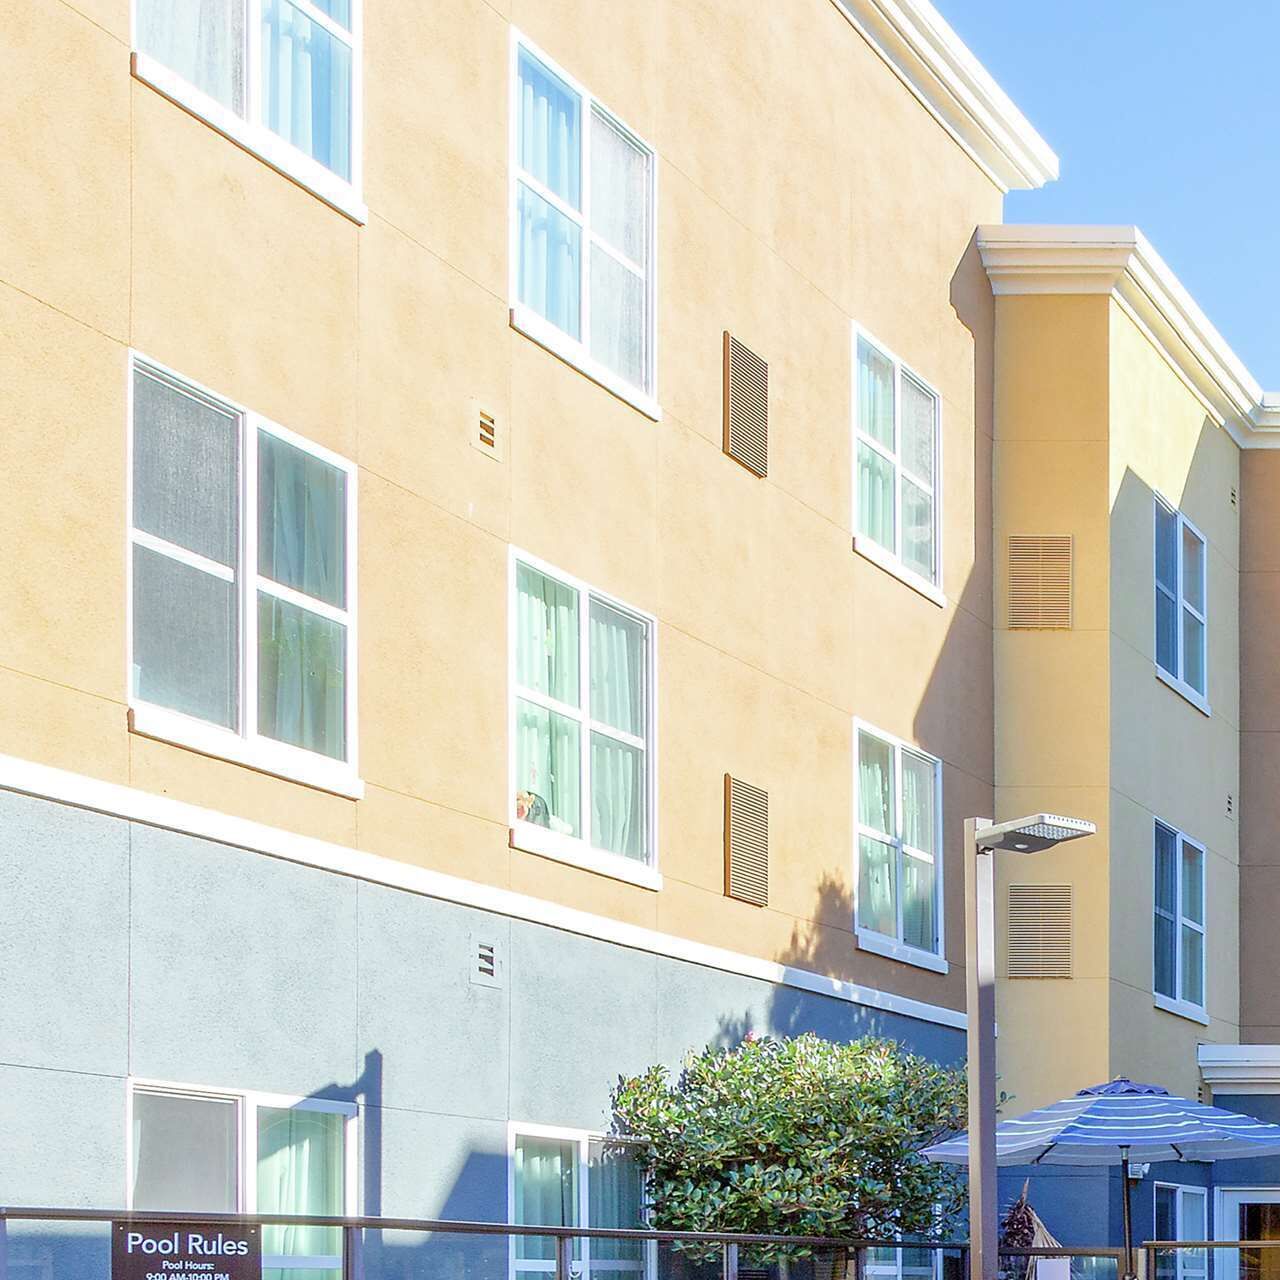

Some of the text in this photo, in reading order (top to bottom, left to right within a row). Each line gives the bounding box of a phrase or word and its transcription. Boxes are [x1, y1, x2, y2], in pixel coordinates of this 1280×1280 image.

[127, 1232, 248, 1255] Pool Rules
[162, 1260, 215, 1270] Pool Hours:
